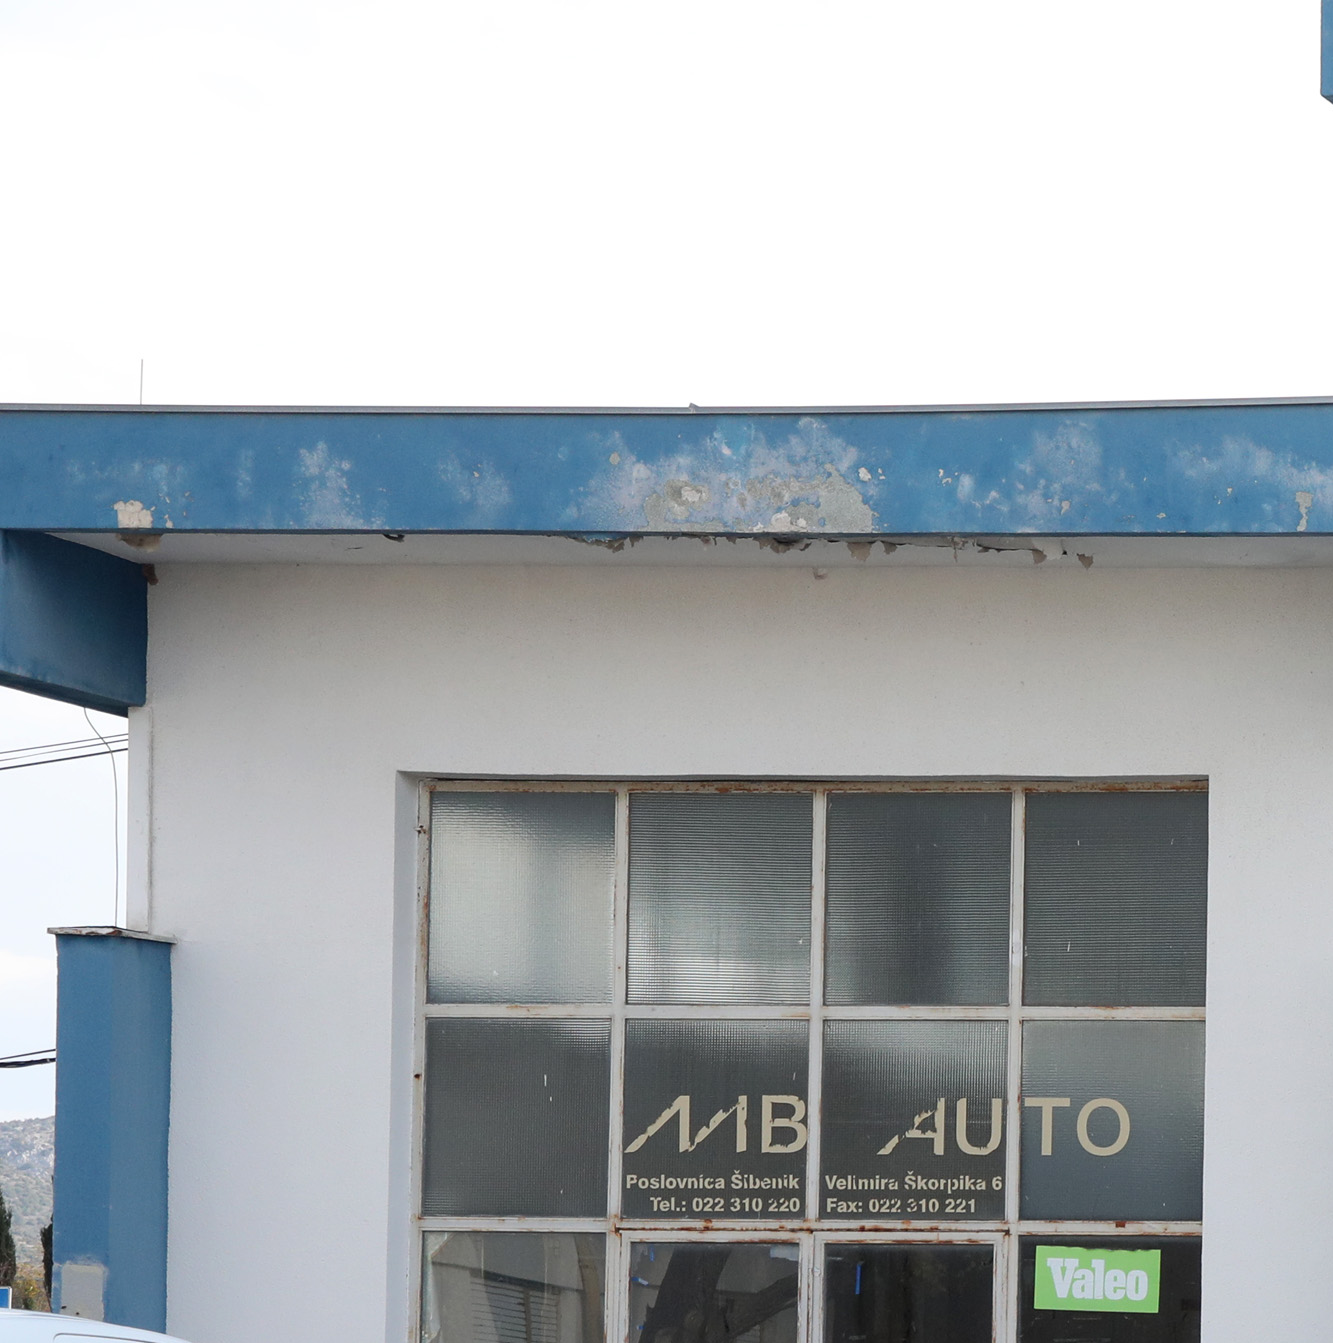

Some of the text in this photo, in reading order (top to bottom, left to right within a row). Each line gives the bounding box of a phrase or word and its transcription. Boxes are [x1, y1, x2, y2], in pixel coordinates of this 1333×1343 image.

[877, 1096, 1131, 1157] AUTO
[626, 1169, 801, 1189] Poslovnica Šibenik
[825, 1170, 1003, 1194] Velimira Škorpika 6
[650, 1197, 801, 1212] Tel.: 022 310 220
[826, 1197, 977, 1213] Fax: 022 310 221
[1046, 1257, 1149, 1301] Valeo
